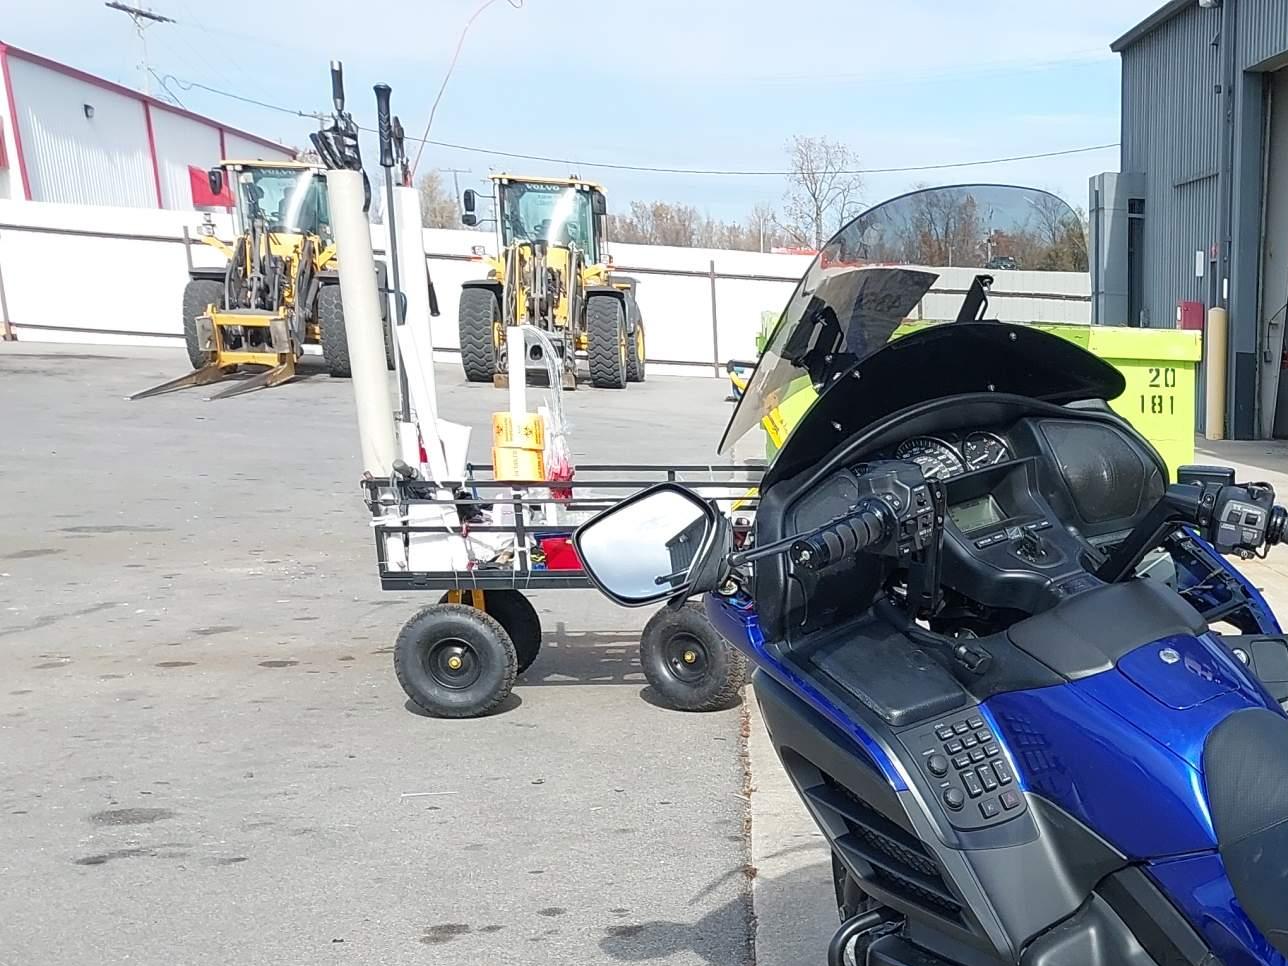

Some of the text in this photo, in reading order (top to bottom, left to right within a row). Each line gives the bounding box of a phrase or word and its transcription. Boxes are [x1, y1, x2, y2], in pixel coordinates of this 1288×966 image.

[524, 183, 560, 191] VOLVO
[1148, 368, 1176, 388] 20
[1140, 394, 1174, 415] 181
